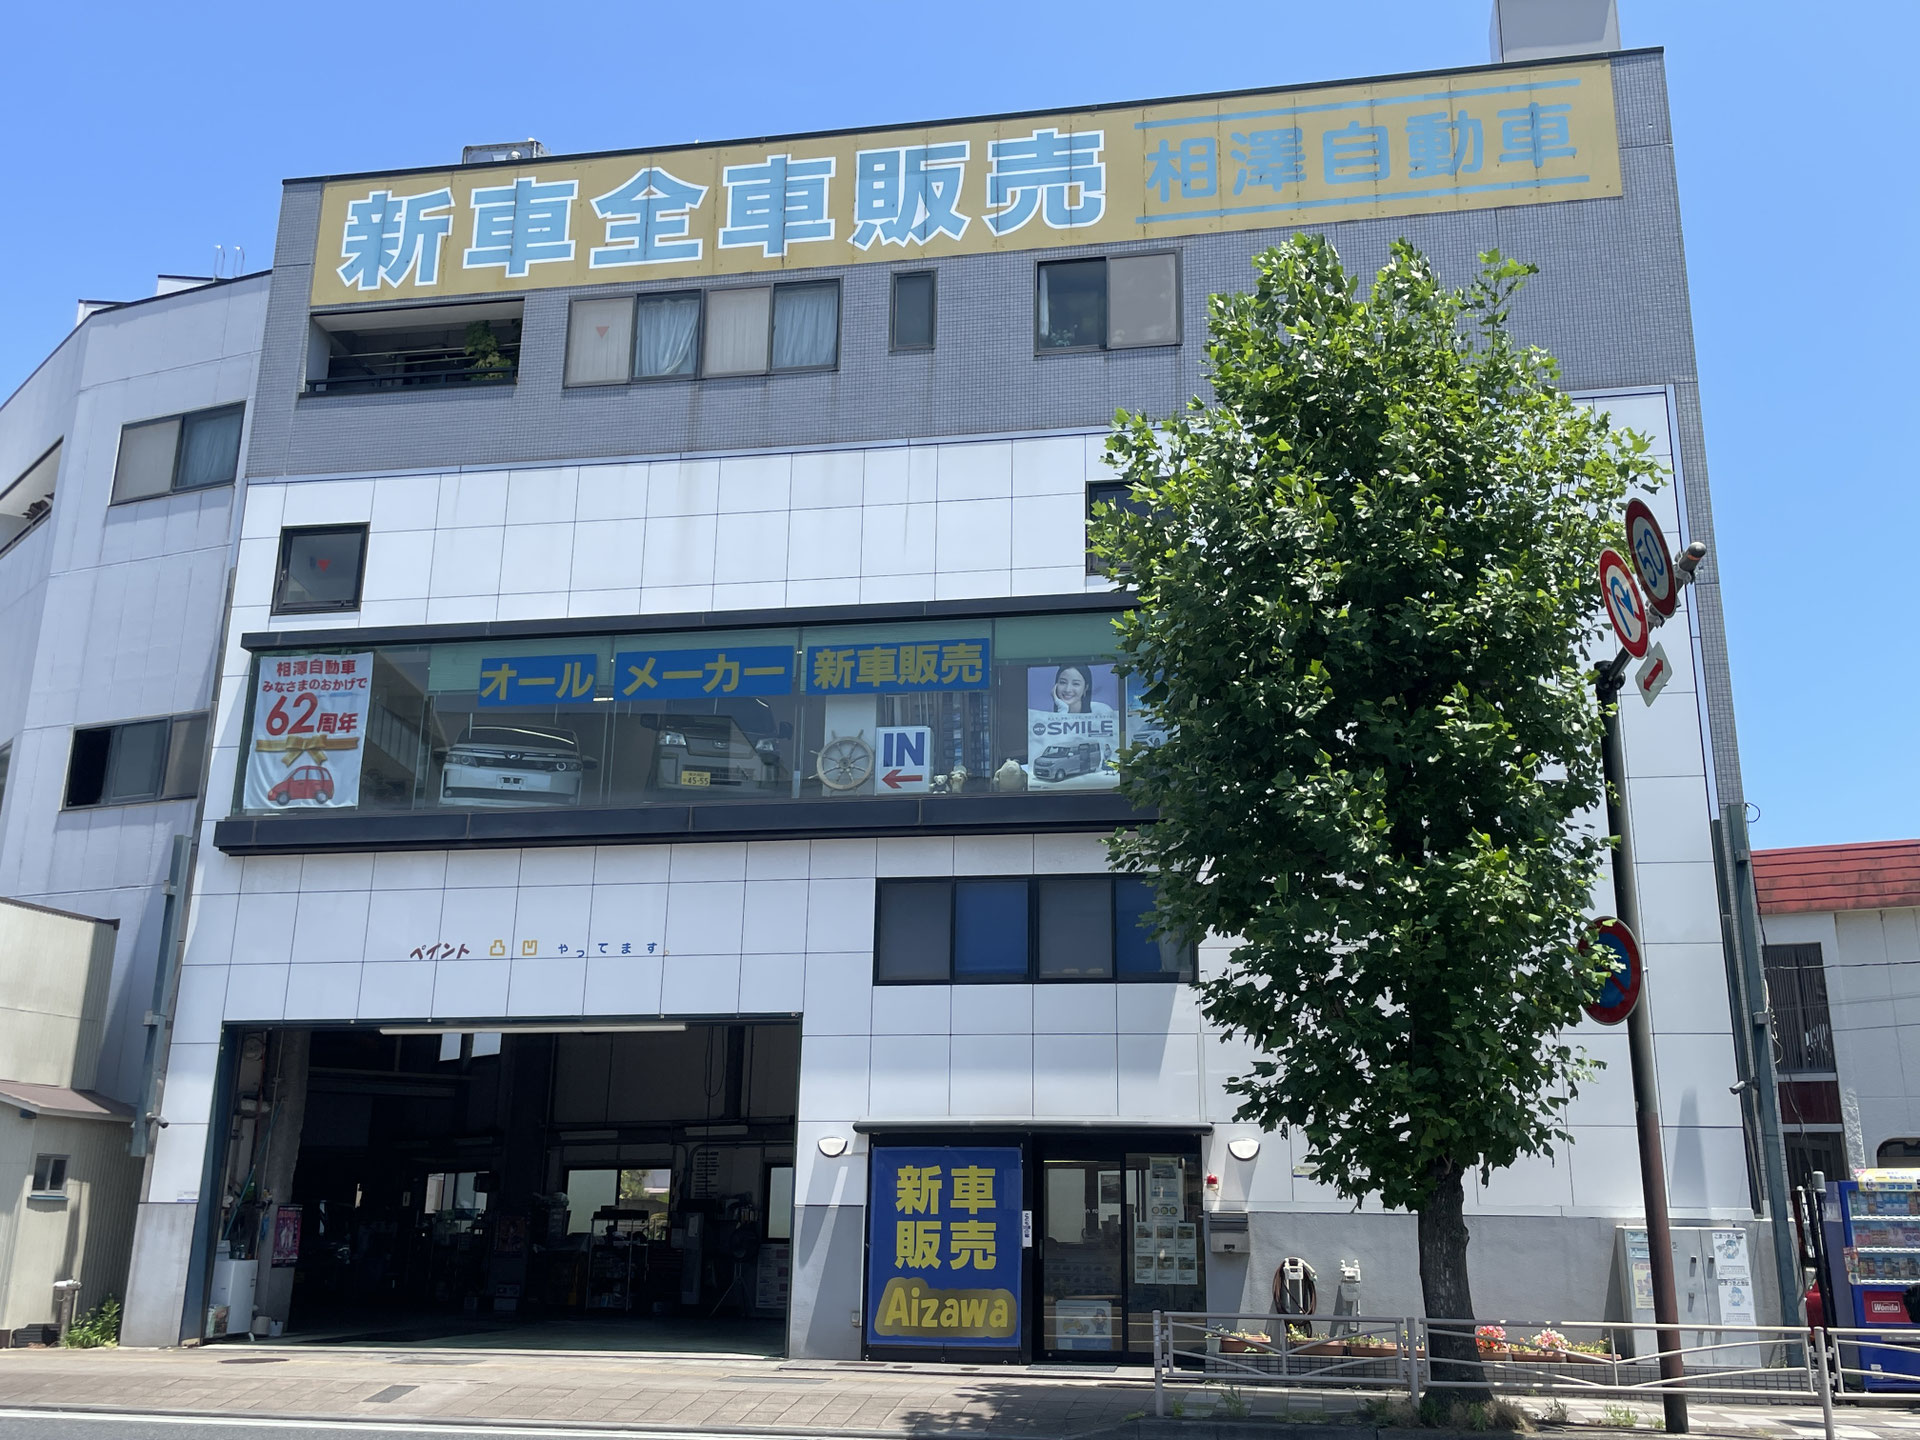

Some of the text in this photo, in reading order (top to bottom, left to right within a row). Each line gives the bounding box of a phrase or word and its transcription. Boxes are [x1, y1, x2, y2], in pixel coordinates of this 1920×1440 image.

[1146, 101, 1578, 203] 相澤自動車
[336, 128, 1106, 291] 新車全車販売
[1635, 528, 1665, 589] 50
[262, 677, 368, 693] みなさまのおかげで
[276, 659, 357, 677] 相澤自動車
[480, 642, 984, 701] オール メーカー 新車販売
[266, 692, 359, 736] 62周年
[1047, 720, 1114, 736] SMILE
[882, 731, 926, 768] IN
[687, 776, 709, 786] 45-55
[410, 943, 470, 961] ペイント
[895, 1164, 997, 1216] 新車
[895, 1220, 997, 1271] 販売
[883, 1286, 1009, 1328] Aizawa
[1873, 1303, 1899, 1312] Wonda
